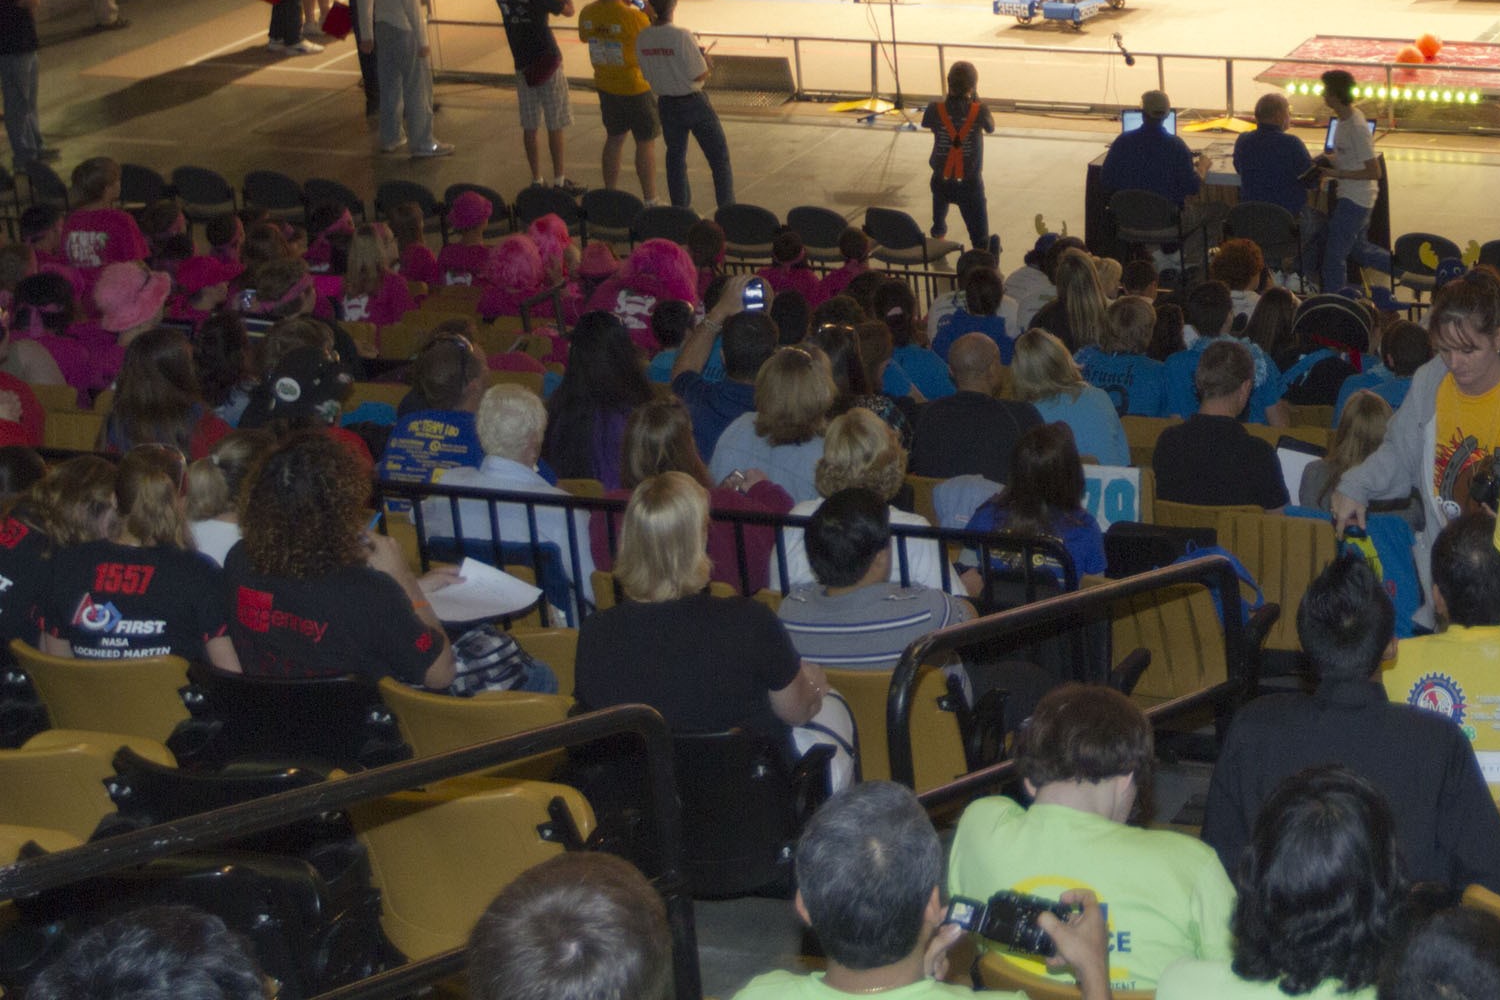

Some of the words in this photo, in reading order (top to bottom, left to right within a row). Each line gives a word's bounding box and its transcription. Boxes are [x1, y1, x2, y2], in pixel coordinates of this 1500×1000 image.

[94, 562, 156, 595] 1557
[115, 620, 167, 635] FIRST
[101, 637, 129, 647] NASA
[74, 646, 120, 658] LOCKHEED
[123, 646, 171, 658] MARTIN
